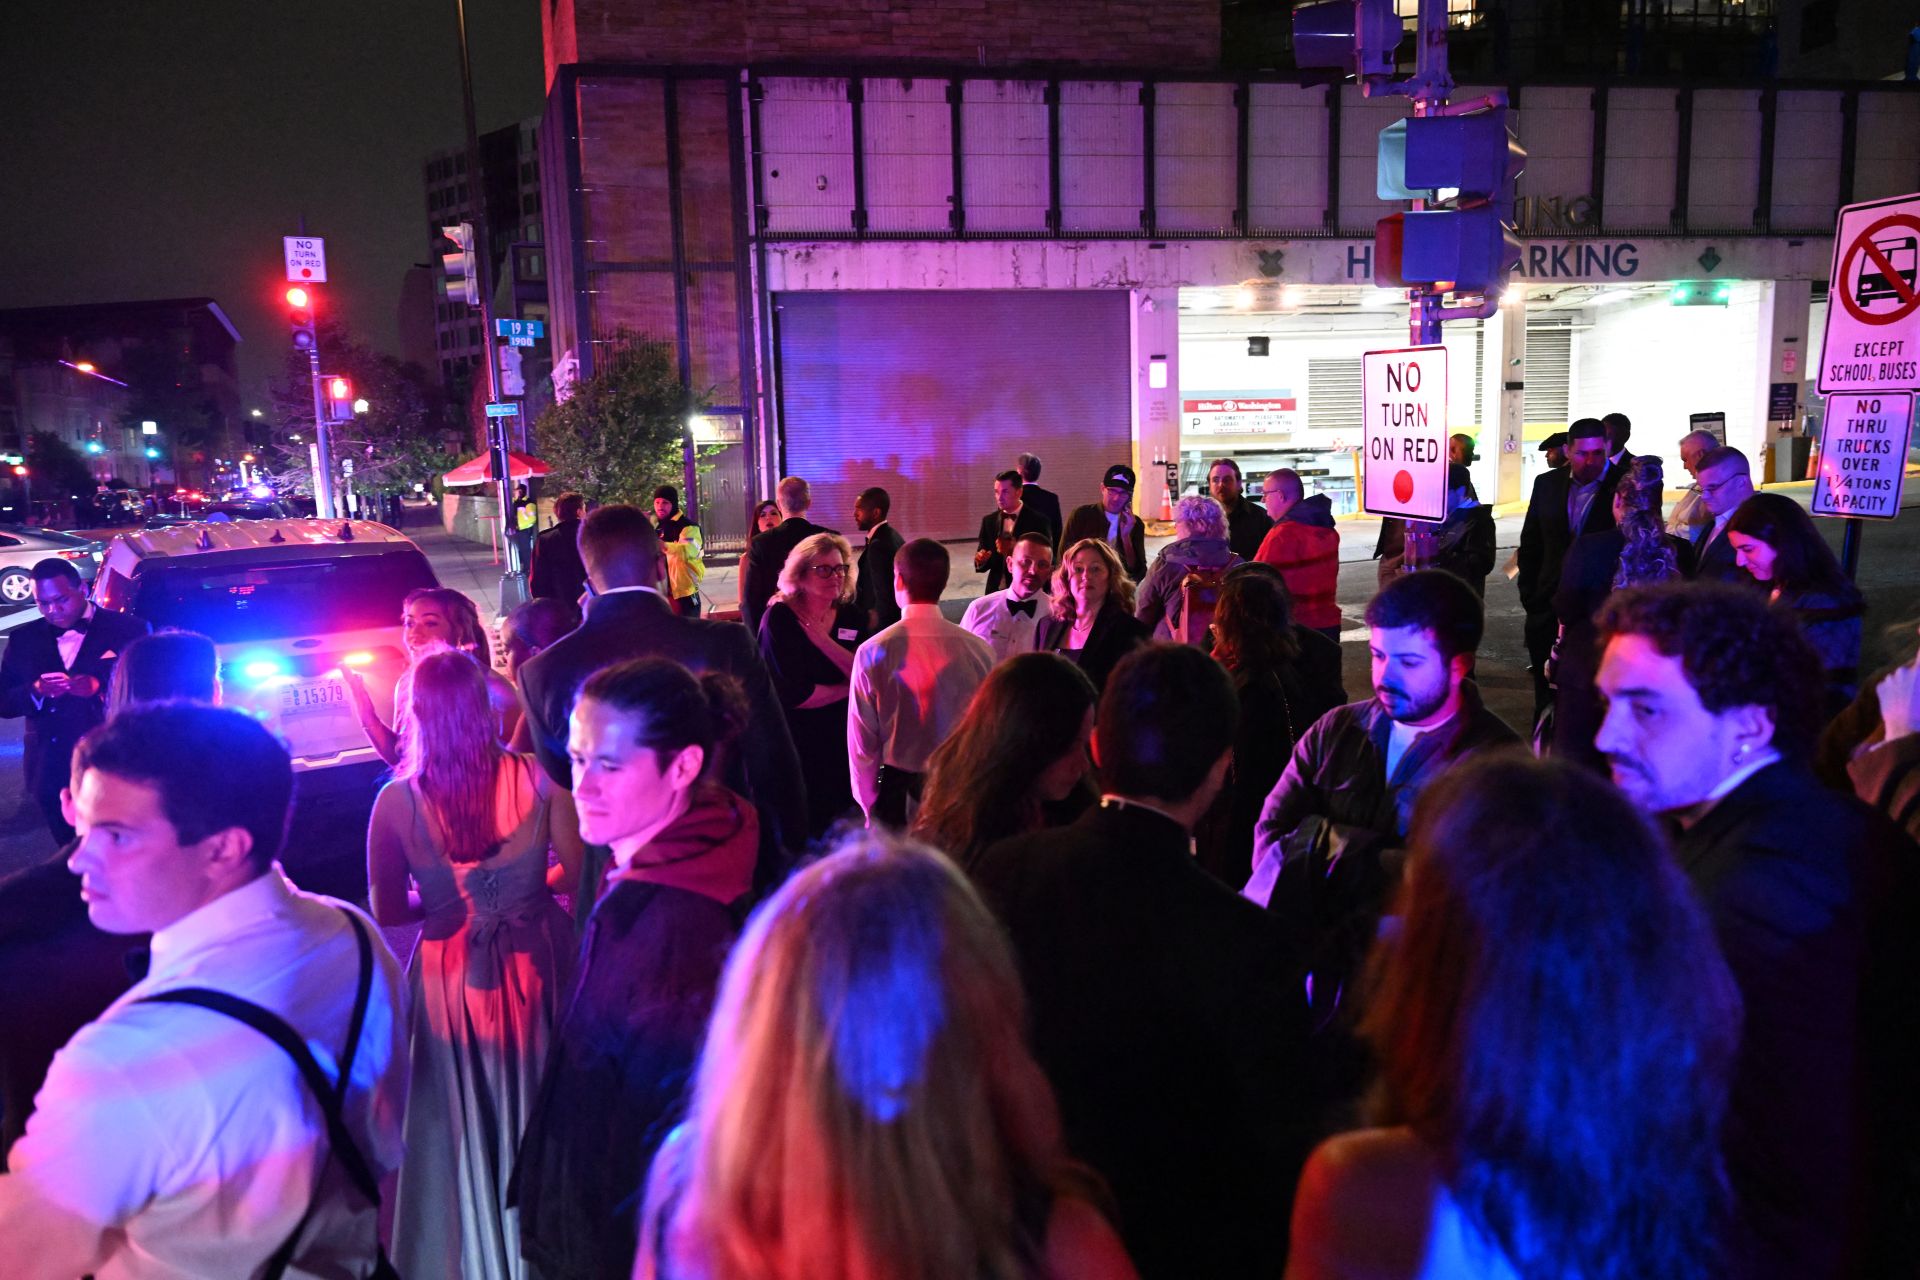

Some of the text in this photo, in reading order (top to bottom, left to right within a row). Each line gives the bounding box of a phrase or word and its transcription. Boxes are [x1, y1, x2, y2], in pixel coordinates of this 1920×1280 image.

[296, 240, 313, 249] NO
[294, 250, 316, 258] TURN
[1510, 243, 1639, 278] ARKING
[290, 259, 321, 268] ON RED
[511, 322, 521, 335] 19
[511, 337, 533, 346] 1900
[1854, 340, 1904, 358] EXCEPT
[1386, 361, 1422, 393] NO
[1829, 361, 1917, 382] SCHOOL BUSES
[1856, 399, 1881, 415] NO
[1381, 402, 1428, 428] TURN
[1192, 417, 1201, 430] P
[1847, 419, 1887, 434] THRU
[1371, 436, 1439, 463] ON RED
[1837, 439, 1892, 454] TRUCKS
[1841, 457, 1880, 472] OVER
[1856, 477, 1892, 491] TONS
[1823, 492, 1888, 511] CAPACITY
[303, 684, 344, 705] 15379
